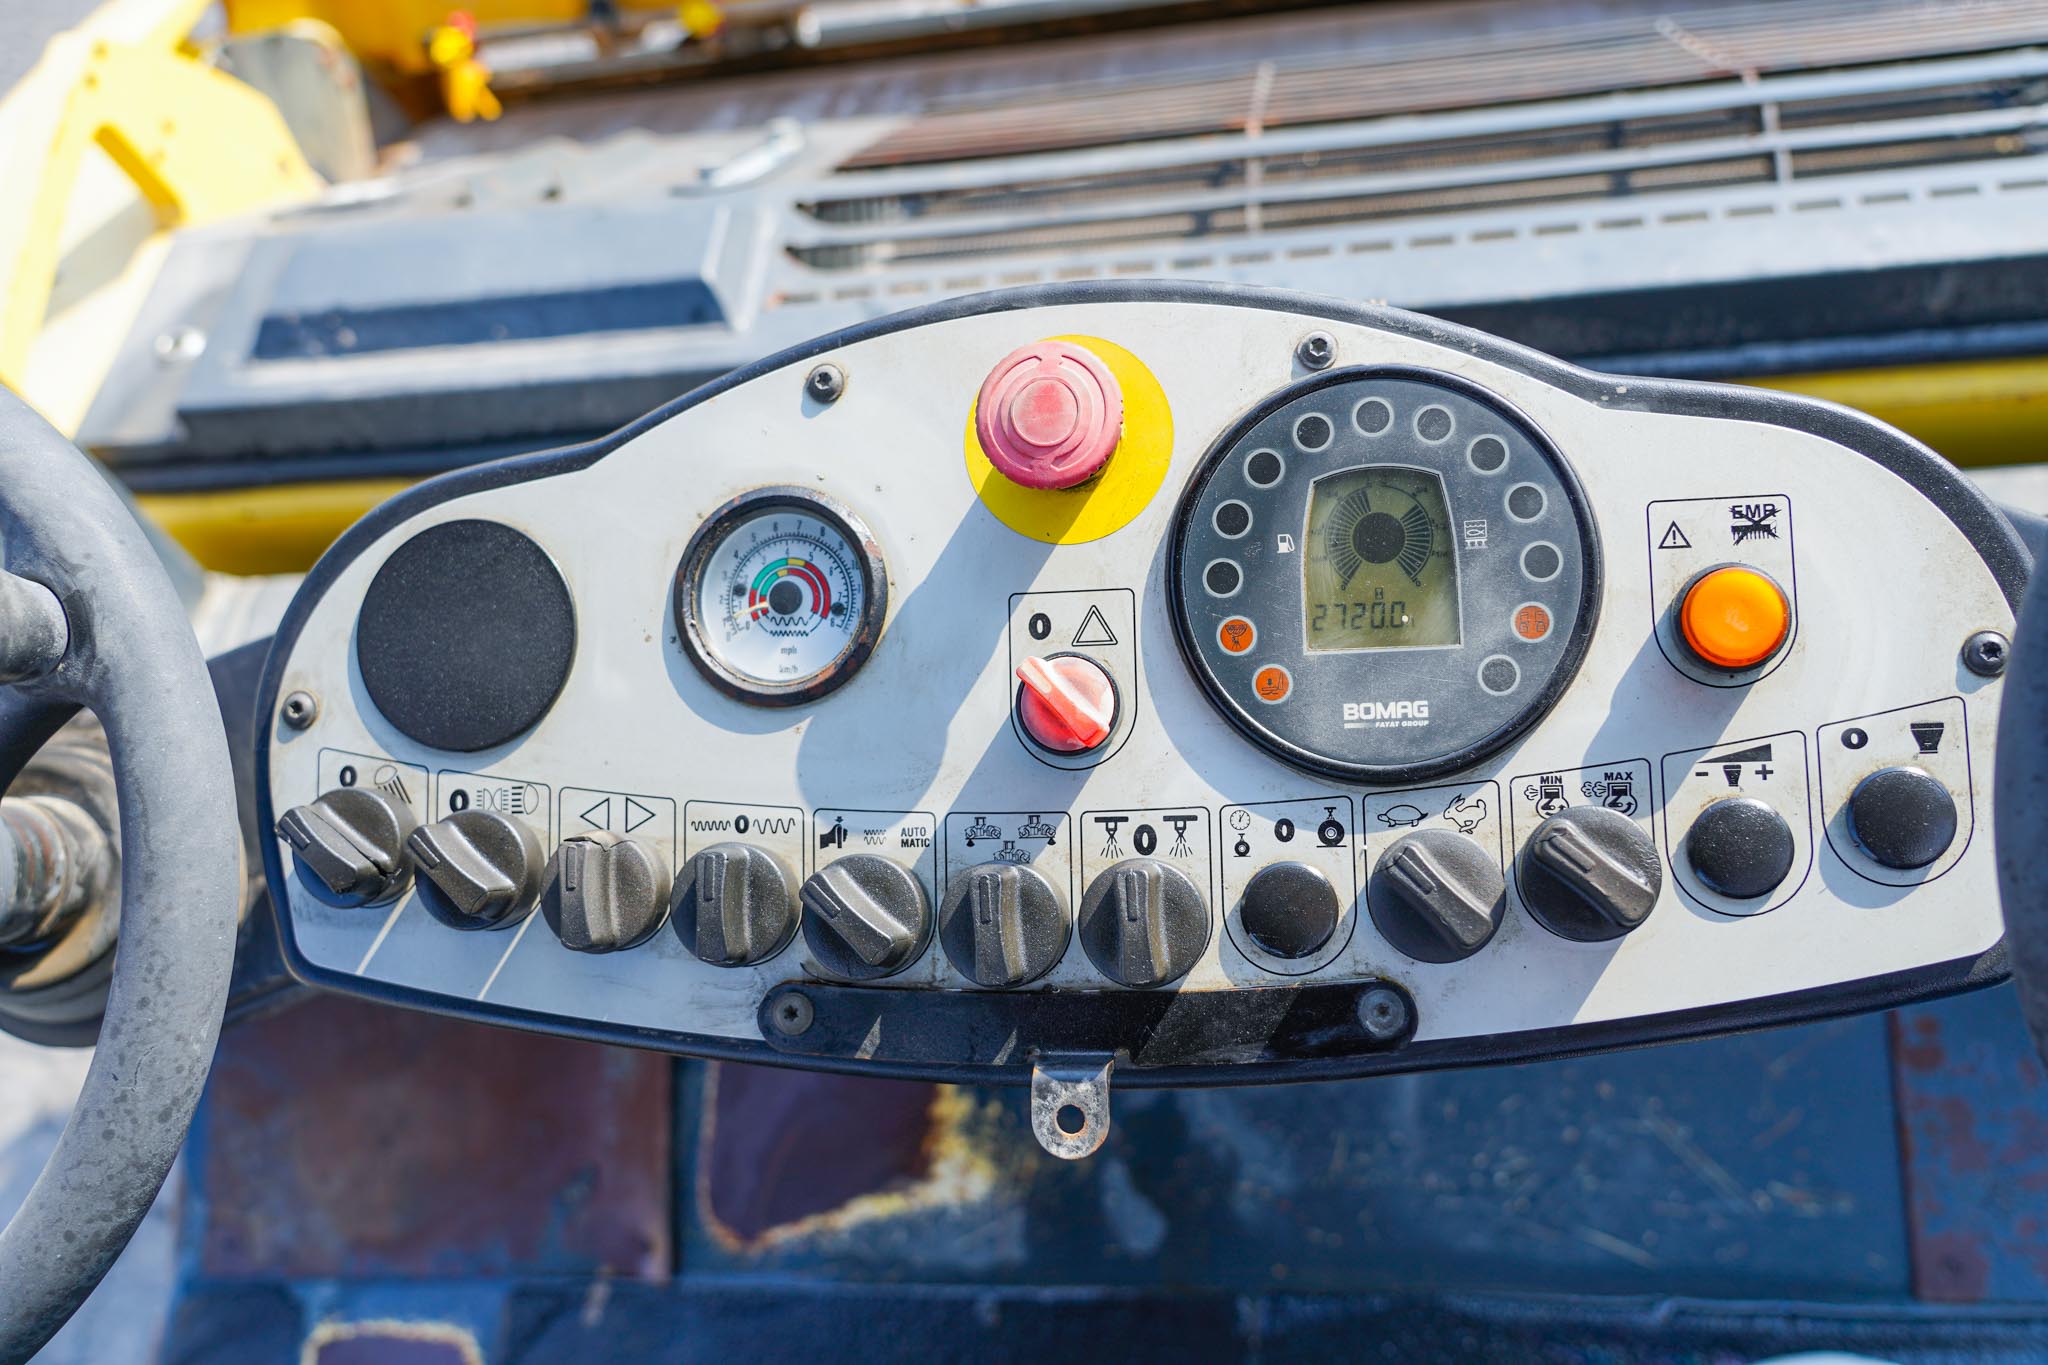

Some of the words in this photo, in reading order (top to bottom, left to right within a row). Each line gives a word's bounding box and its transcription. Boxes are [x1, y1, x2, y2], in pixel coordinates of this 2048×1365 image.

[1028, 612, 1052, 641] 0
[1312, 601, 1406, 632] 2720.0
[1343, 700, 1429, 720] BOMAG
[1401, 720, 1429, 728] GROUP
[1841, 727, 1868, 749] 0
[339, 765, 358, 788] 0
[1540, 775, 1563, 785] MIN
[1604, 771, 1633, 781] MAX
[450, 788, 470, 813] 0
[734, 814, 750, 834] 0
[901, 827, 927, 837] AUTO
[1274, 817, 1295, 843] 0
[901, 838, 930, 848] MATIC
[1133, 823, 1158, 856] 0
